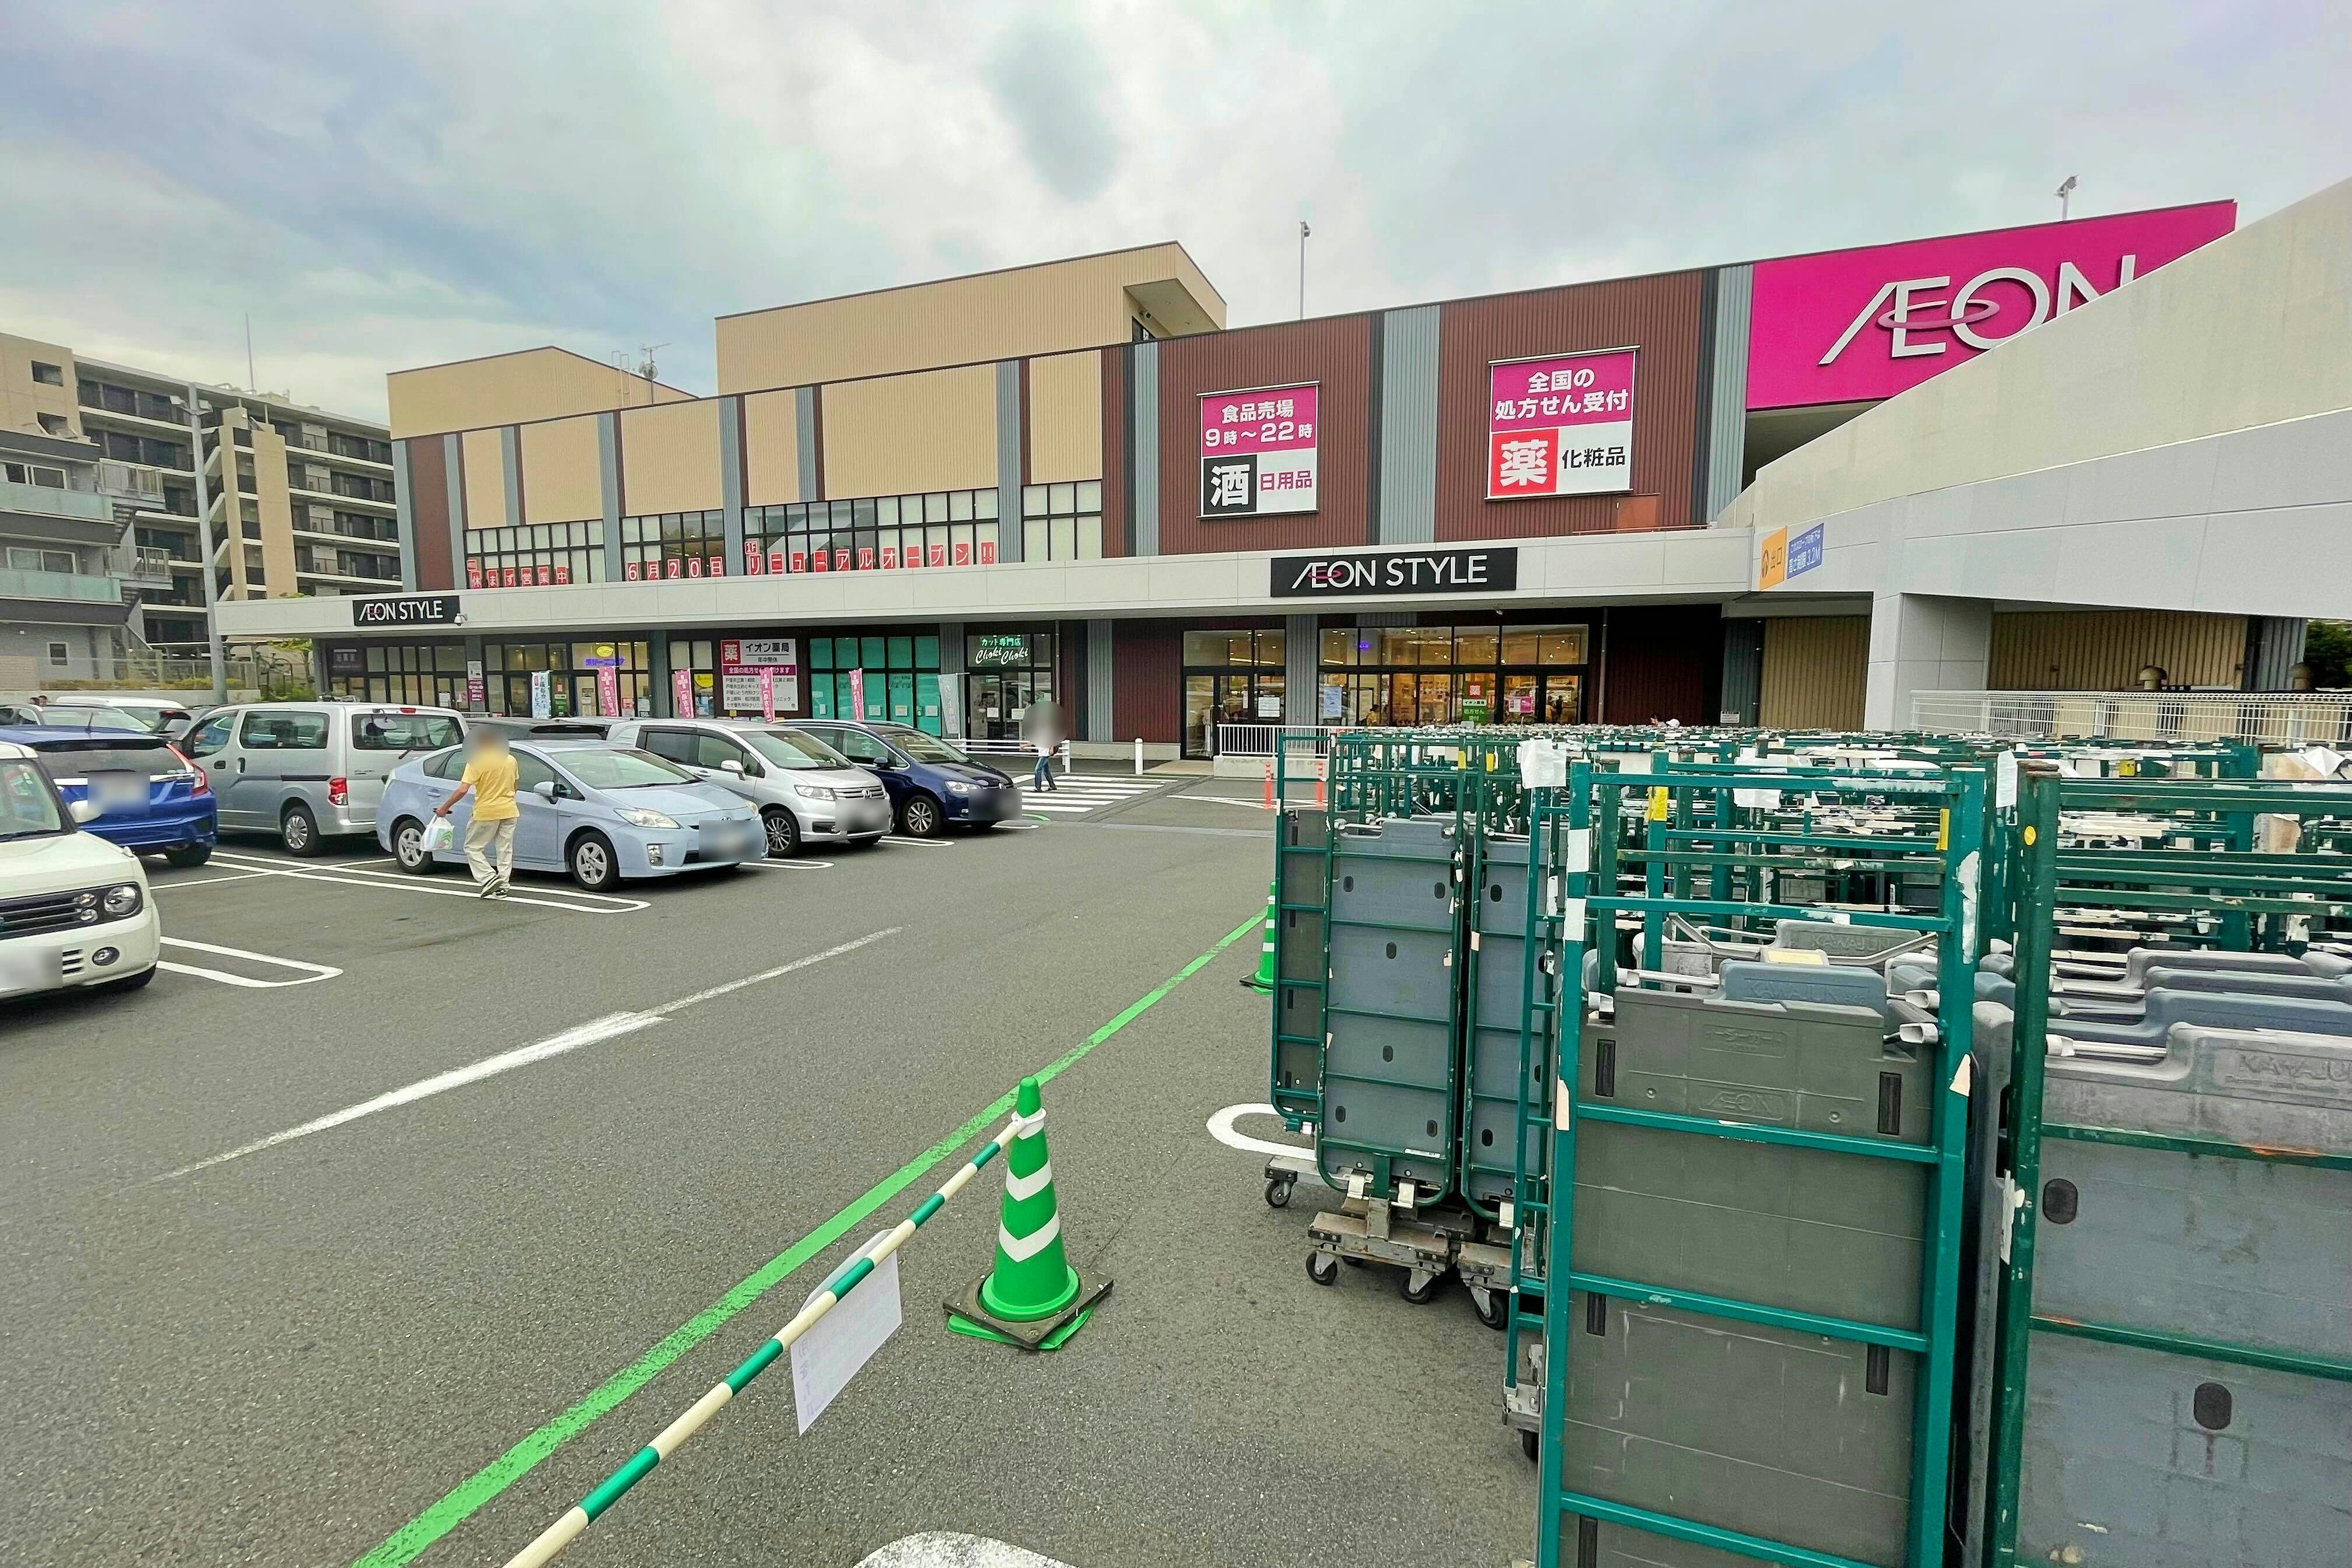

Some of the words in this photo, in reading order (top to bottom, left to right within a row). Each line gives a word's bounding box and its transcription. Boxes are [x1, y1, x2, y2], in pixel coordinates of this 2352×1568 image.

[1528, 369, 1595, 394] 全国の
[1222, 399, 1294, 424] 食品売場
[1494, 389, 1629, 421] 処方せん受付
[1499, 439, 1549, 487] 薬
[1562, 446, 1626, 469] 化粧品
[1210, 464, 1250, 506] 酒
[1260, 471, 1312, 491] 日用品
[746, 542, 757, 553] 1F
[1770, 547, 1783, 569] 出口
[473, 569, 566, 589] 休まず営業中
[627, 558, 723, 581] 6月20日
[1386, 555, 1488, 587] STYLE
[399, 600, 443, 620] STYLE
[724, 645, 738, 661] 薬
[746, 642, 789, 653] イオン薬局
[981, 638, 1021, 648] カット専門店
[975, 646, 1003, 665] Choki
[1000, 646, 1029, 666] Choki
